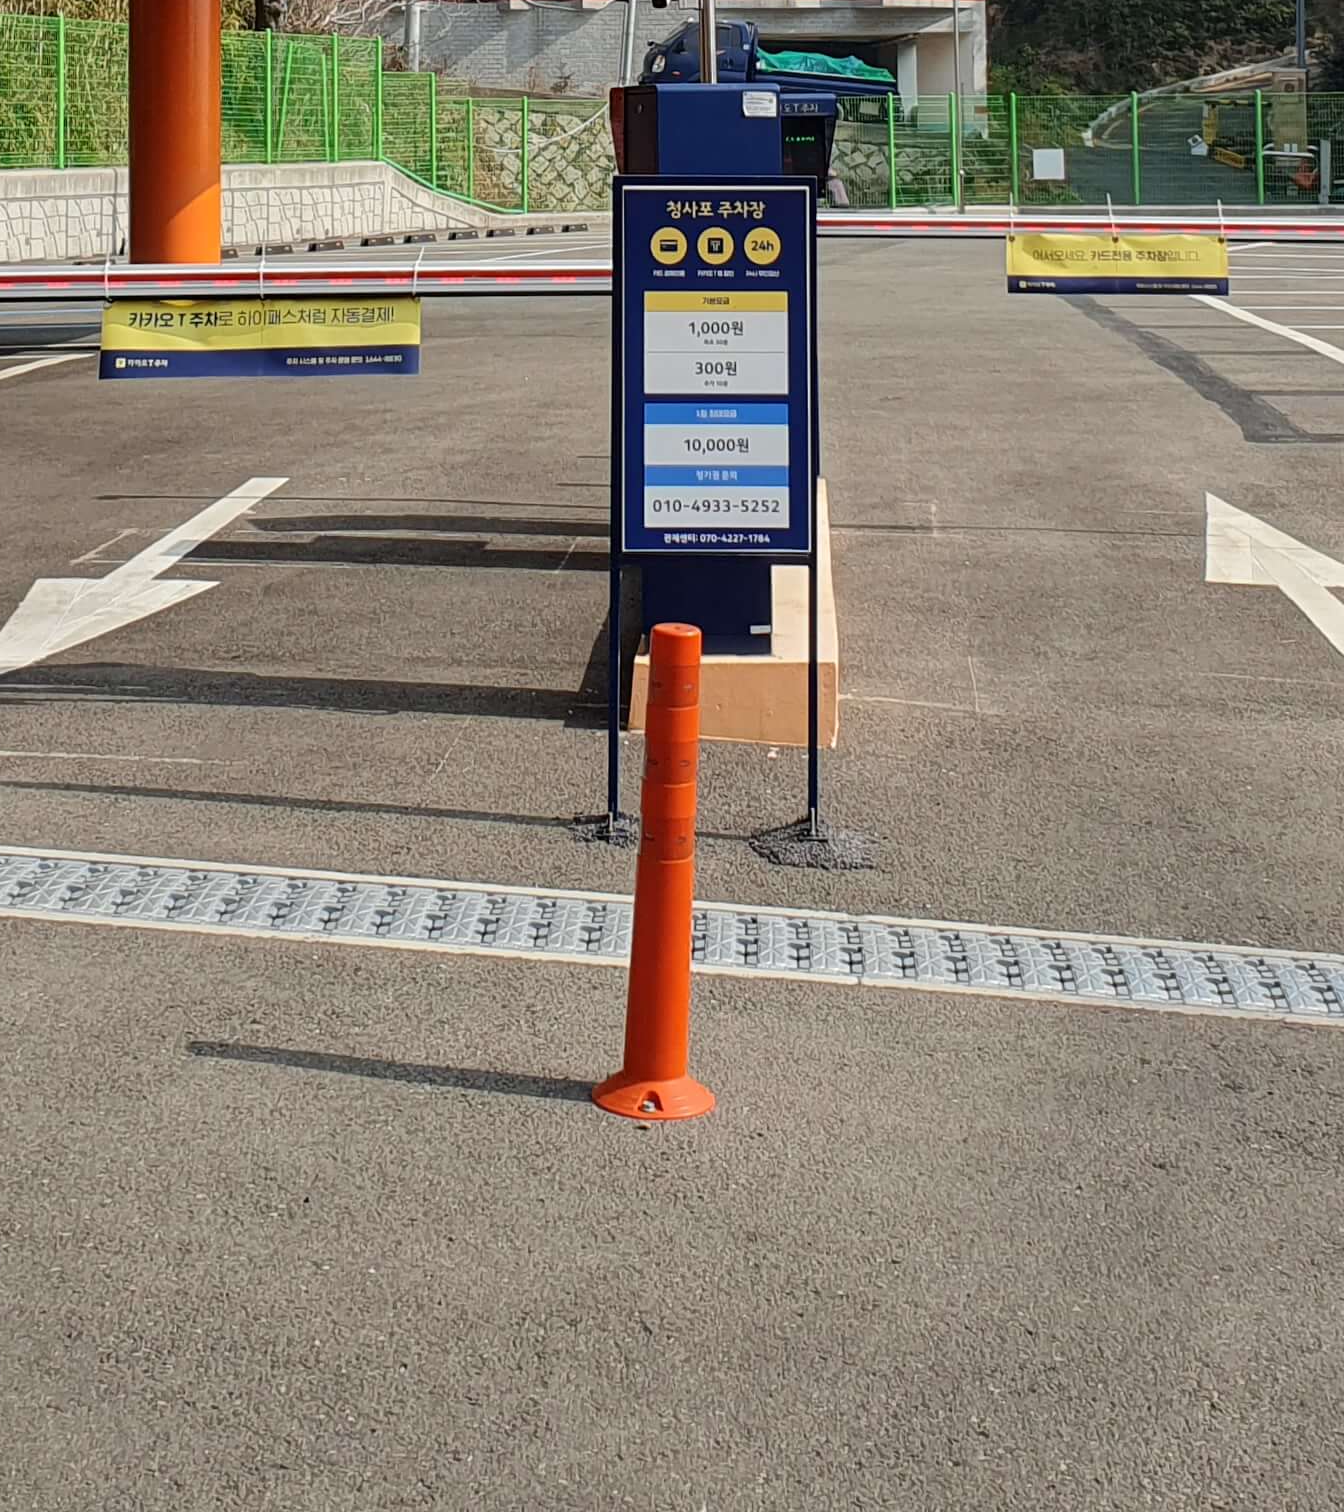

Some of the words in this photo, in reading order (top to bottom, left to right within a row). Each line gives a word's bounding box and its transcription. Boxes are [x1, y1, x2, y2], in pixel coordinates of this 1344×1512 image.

[666, 200, 714, 219] 청사포
[717, 200, 766, 219] 주차장
[751, 240, 774, 251] 24h
[128, 311, 174, 328] 카카오
[178, 312, 187, 327] T
[190, 310, 233, 328] 주차로
[238, 308, 326, 328] 하이패스처럼
[331, 306, 394, 324] 자동결제!
[688, 320, 743, 337] 1,000원
[695, 361, 737, 376] 300원
[684, 437, 749, 454] 10,000원
[652, 499, 780, 513] 010-4933-5252
[700, 533, 770, 544] 070-4227-1784
